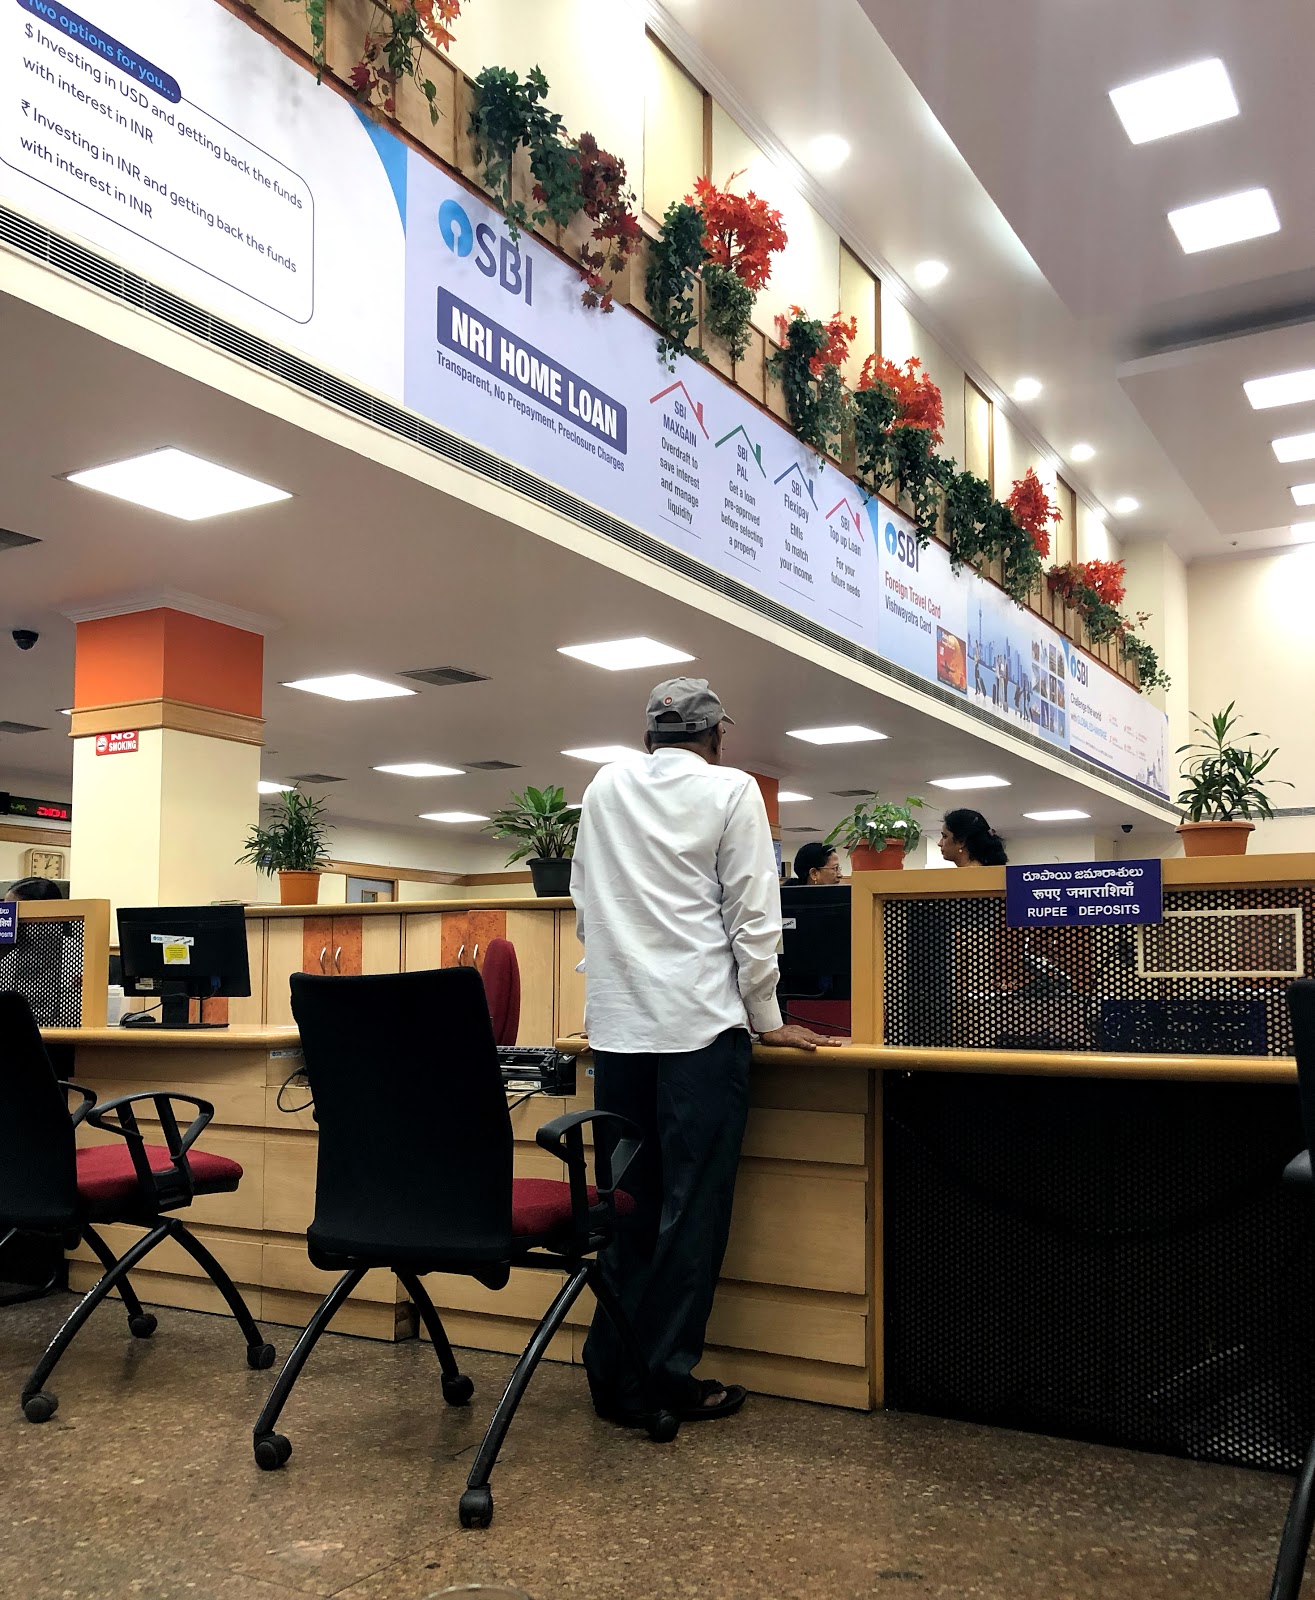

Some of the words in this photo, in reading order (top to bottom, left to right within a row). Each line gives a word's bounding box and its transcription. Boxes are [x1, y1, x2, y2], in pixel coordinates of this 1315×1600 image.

[60, 16, 114, 57] options
[116, 48, 136, 70] for
[138, 64, 174, 97] you...
[23, 56, 54, 84] with
[58, 74, 112, 119] interest
[116, 110, 127, 128] in
[131, 119, 153, 144] INR
[24, 22, 34, 38] $
[37, 30, 101, 83] Investing
[104, 72, 116, 90] in
[120, 80, 148, 108] USD
[151, 104, 174, 126] and
[177, 122, 221, 159] getting
[224, 148, 250, 175] back
[253, 168, 271, 188] the
[273, 180, 302, 209] funds
[20, 136, 52, 163] with
[56, 154, 111, 196] interest
[115, 187, 126, 204] in
[130, 195, 152, 219] INR
[21, 99, 30, 117] ₹
[34, 108, 99, 159] Investing
[102, 148, 114, 165] in
[118, 156, 140, 181] INR
[144, 175, 167, 196] and
[170, 191, 214, 227] getting
[217, 215, 244, 242] back
[246, 233, 264, 254] the
[267, 246, 296, 272] funds
[474, 222, 532, 307] SBI
[452, 306, 492, 364] NRI
[500, 336, 562, 407] HOME
[568, 380, 616, 440] LOAN
[437, 350, 492, 396] Transparent,
[494, 383, 506, 401] No
[508, 390, 556, 434] Prepayment,
[558, 422, 595, 455] Preclosure
[597, 445, 624, 472] Charges
[675, 400, 687, 420] SBI
[663, 414, 697, 448] MAXGAIN
[661, 436, 691, 464] Overdraft
[692, 457, 698, 470] to
[737, 444, 748, 462] SBI
[660, 457, 674, 475] save
[677, 464, 700, 490] interest
[736, 463, 748, 482] PAL
[660, 477, 673, 493] and
[675, 485, 699, 508] manage
[729, 480, 739, 496] Get
[740, 489, 744, 498] a
[745, 489, 756, 506] loan
[792, 479, 802, 498] SBI
[668, 498, 693, 525] liquidity
[725, 497, 760, 527] pre-approved
[784, 494, 809, 523] Flexipay
[721, 511, 738, 532] before
[740, 523, 764, 548] selecting
[790, 523, 803, 541] EMIs
[840, 515, 850, 532] SBI
[729, 536, 733, 546] a
[734, 539, 756, 561] property
[785, 539, 791, 552] to
[792, 545, 808, 563] match
[829, 525, 839, 545] Top
[840, 534, 847, 550] up
[848, 538, 861, 556] Loan
[897, 530, 918, 572] SBI
[780, 557, 791, 572] your
[793, 562, 814, 584] income.
[836, 556, 844, 571] For
[845, 564, 855, 578] your
[831, 571, 845, 590] future
[846, 581, 860, 598] needs
[885, 571, 908, 600] Foreign
[909, 586, 926, 610] Travel
[928, 598, 941, 619] Card
[885, 594, 918, 627] Vishwayatra
[920, 616, 931, 634] Card
[1077, 659, 1088, 688] SBI
[108, 740, 137, 751] SMOKING
[110, 732, 135, 740] NO
[1032, 888, 1061, 901] रूपए
[1066, 881, 1134, 899] जमाराशियाँ
[1027, 906, 1067, 917] RUPEE
[1079, 904, 1140, 916] DEPOSITS
